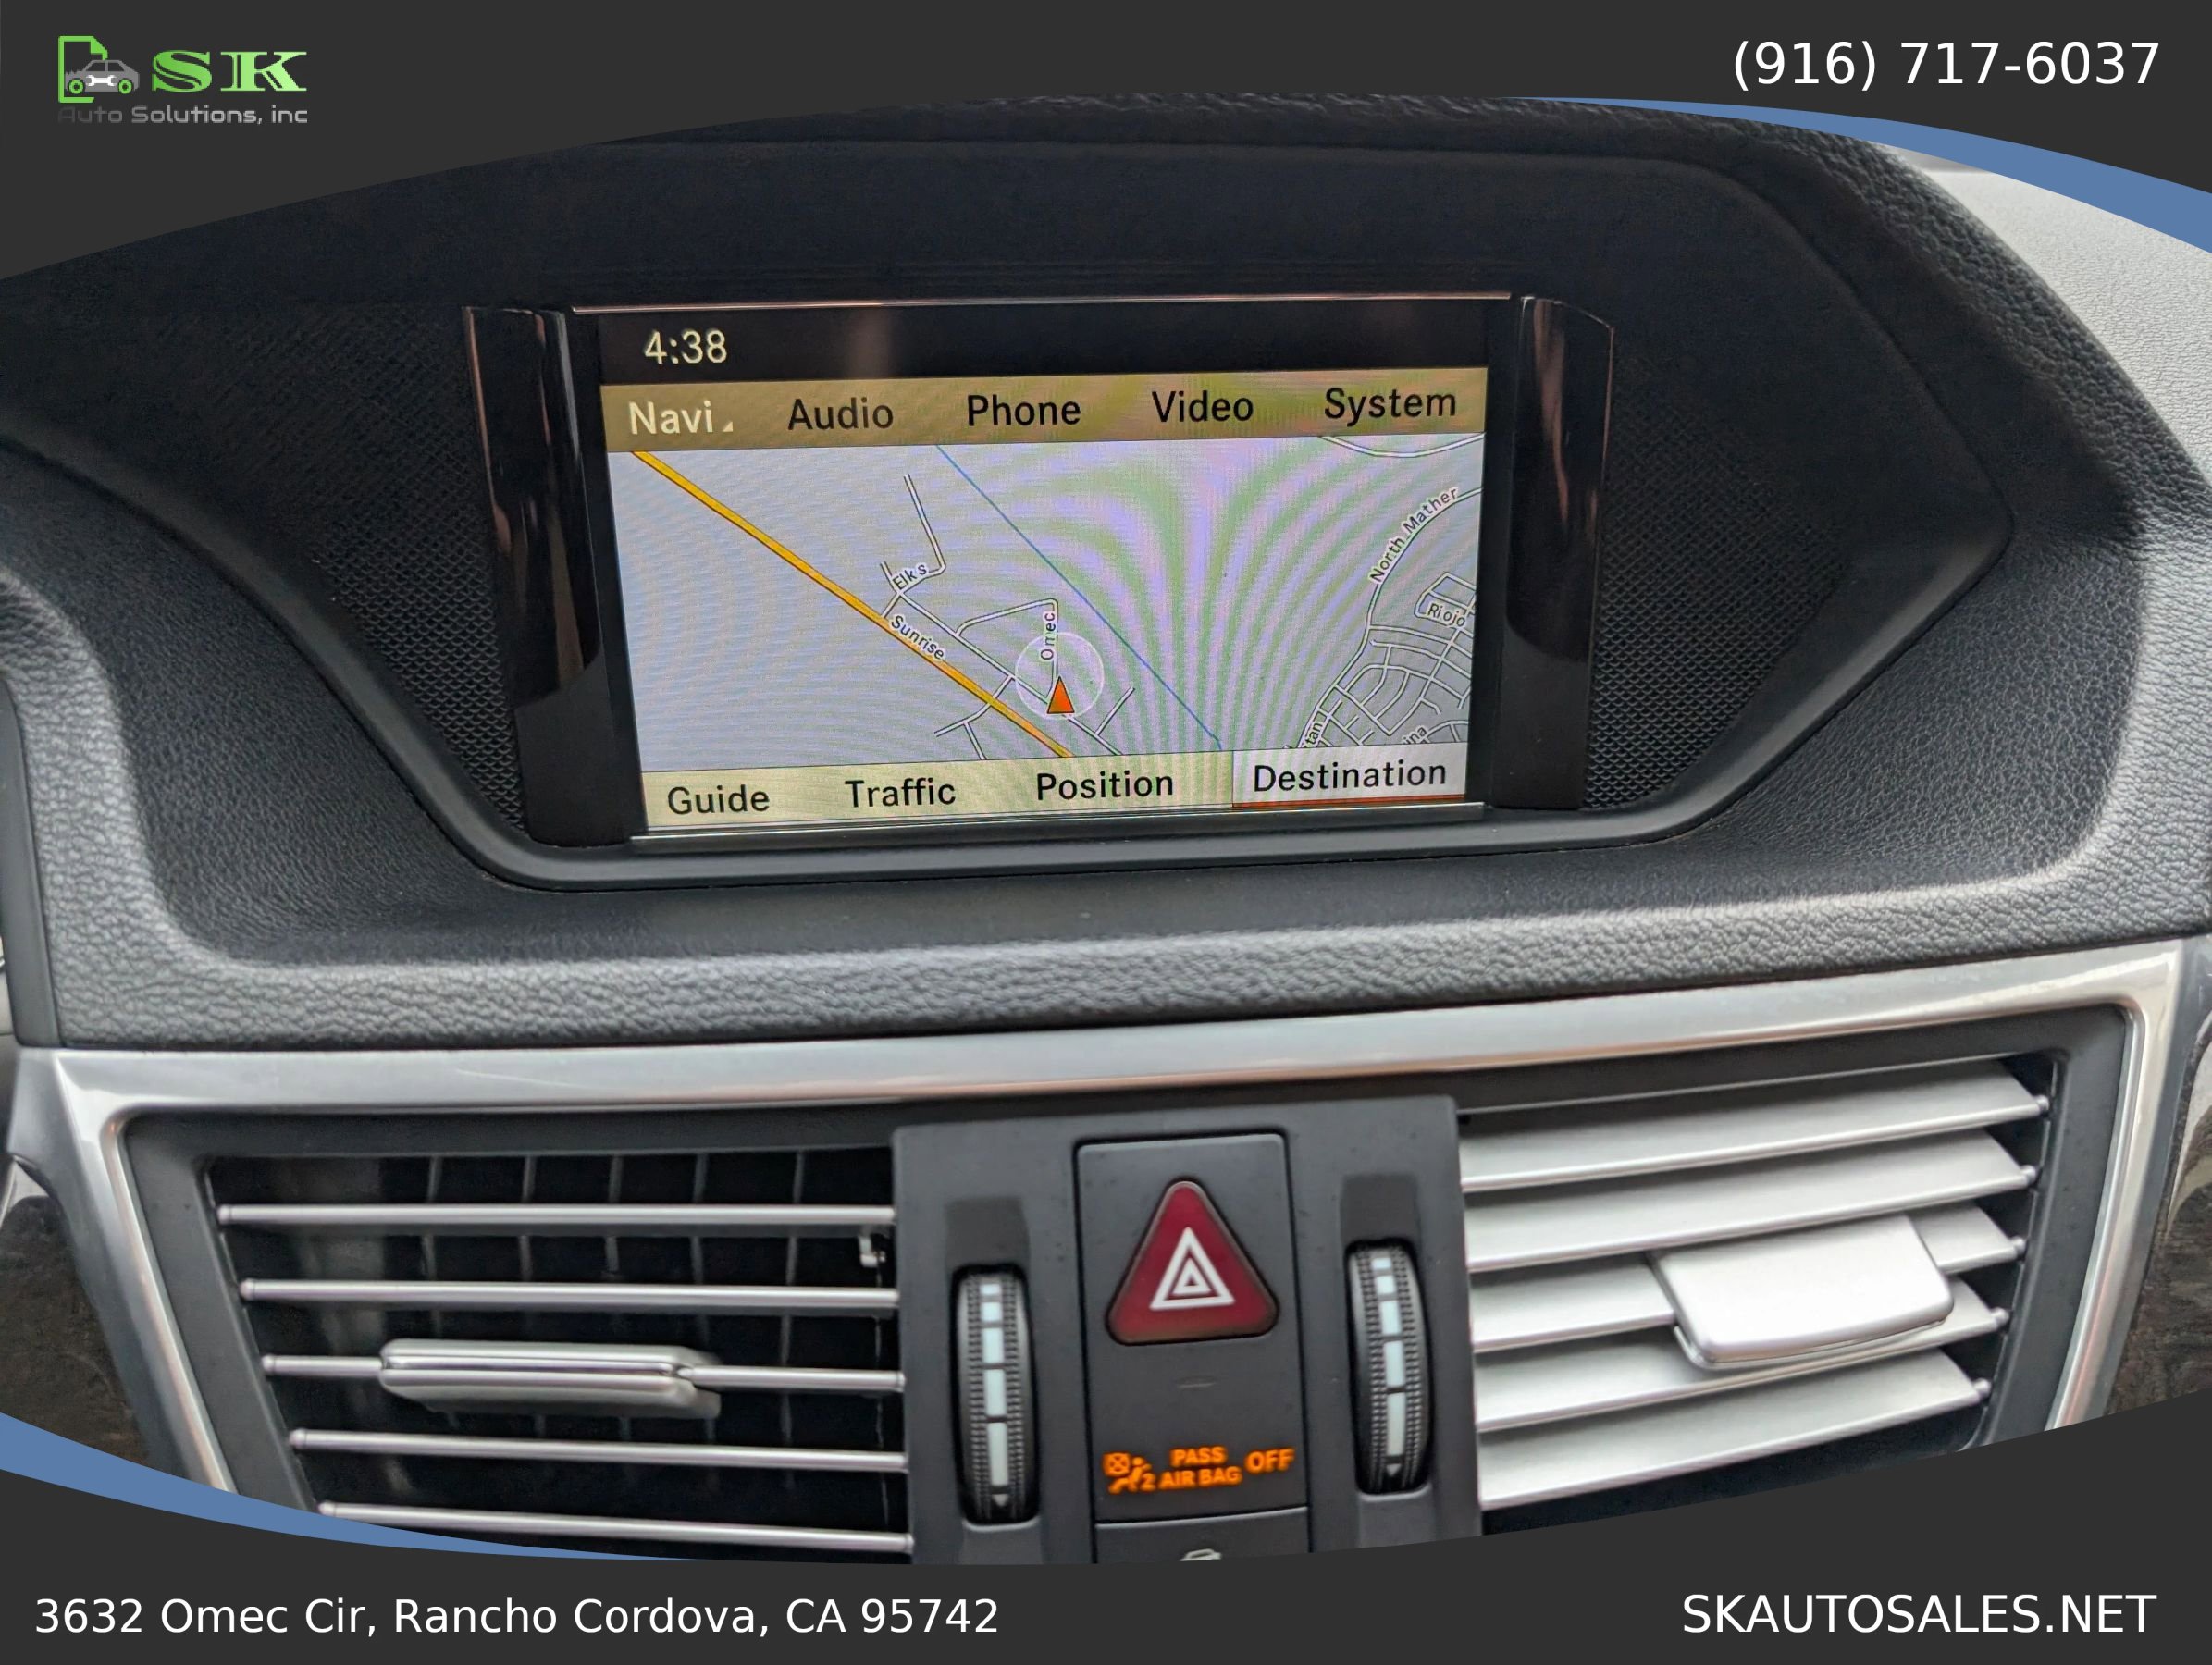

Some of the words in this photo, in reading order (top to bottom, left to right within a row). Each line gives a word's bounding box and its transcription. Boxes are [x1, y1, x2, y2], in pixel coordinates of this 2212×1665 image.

[644, 329, 727, 364] 4:38
[629, 400, 713, 435] Navi
[787, 397, 894, 431] Audio
[967, 394, 1081, 427] Phone
[1151, 389, 1254, 423] Video
[1324, 387, 1456, 428] System
[1369, 536, 1405, 583] North
[1403, 488, 1456, 535] Mather
[891, 615, 944, 660] Sunrise
[1040, 612, 1056, 660] Omec
[1036, 769, 1173, 801] Position
[1254, 758, 1446, 792] Destination
[667, 783, 770, 815] Guide
[844, 777, 956, 808] Traffic
[1170, 1447, 1227, 1467] PASS
[1245, 1448, 1294, 1473] OFF
[1158, 1470, 1196, 1489] AIR
[1198, 1466, 1242, 1486] BAG
